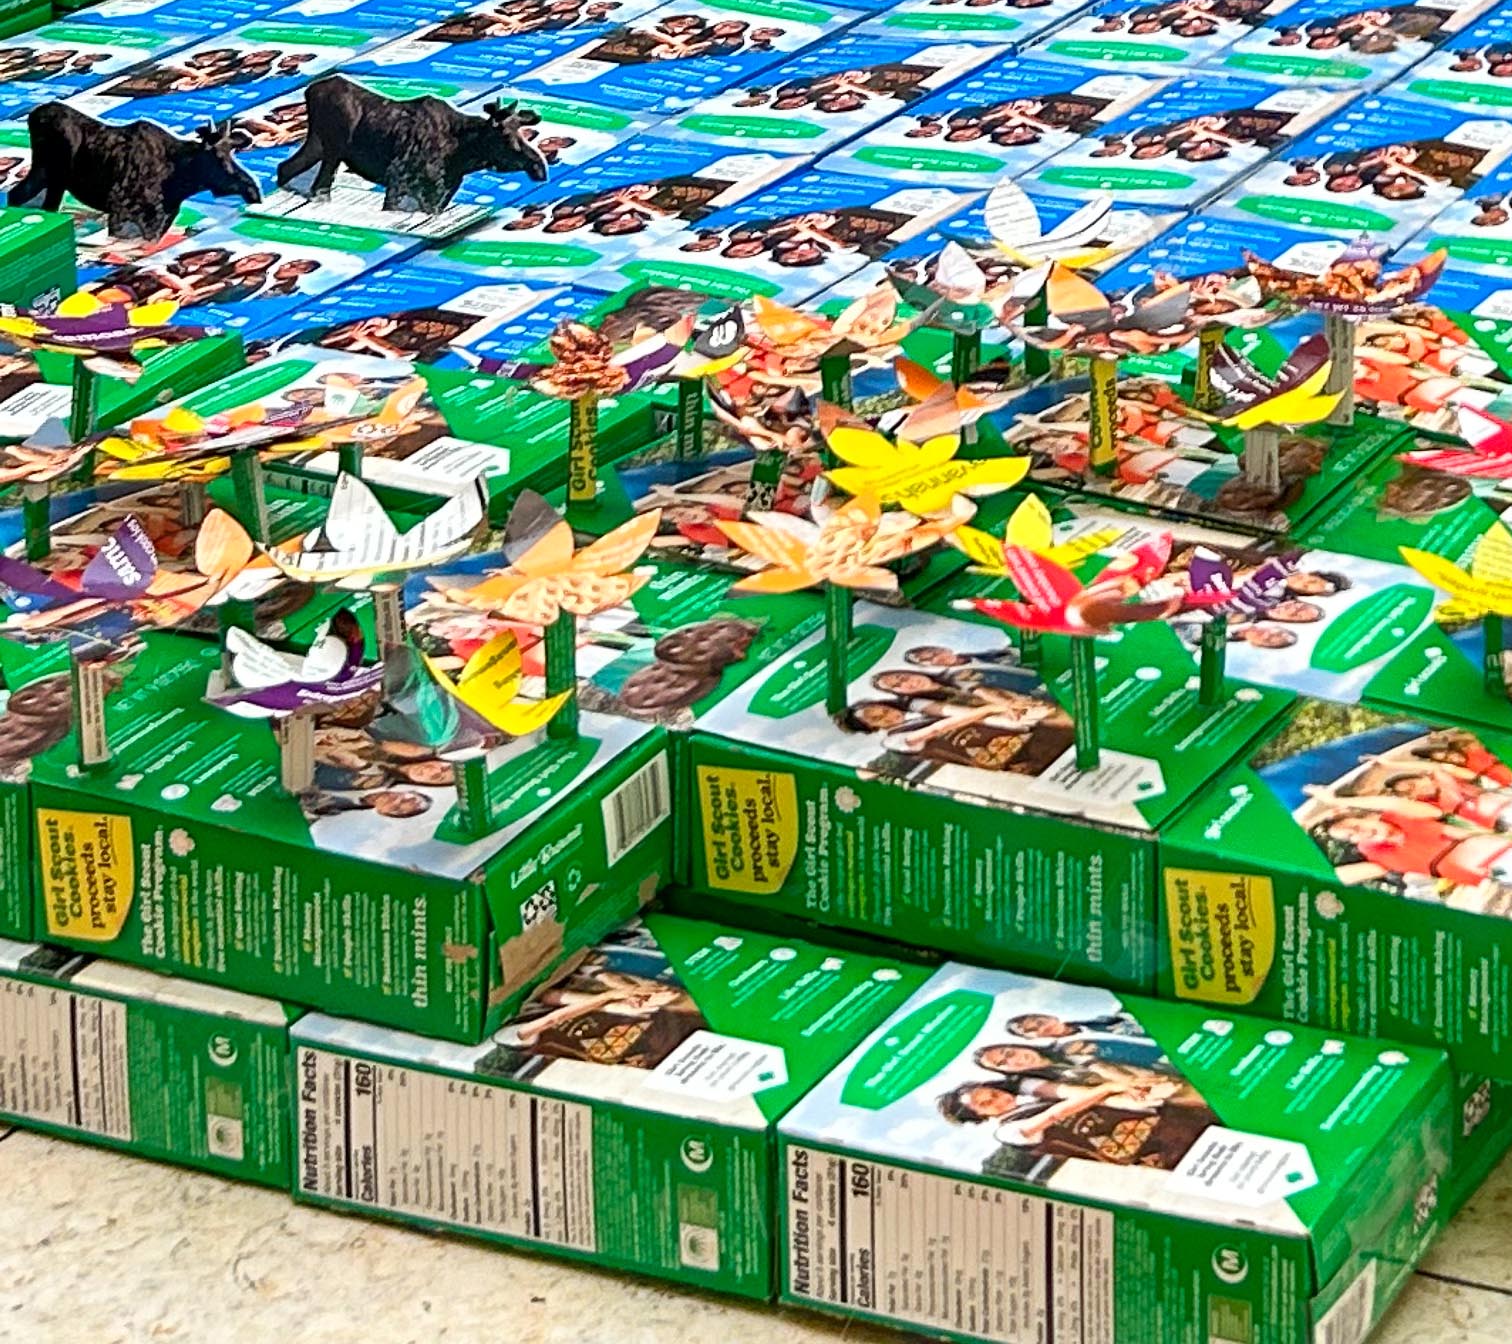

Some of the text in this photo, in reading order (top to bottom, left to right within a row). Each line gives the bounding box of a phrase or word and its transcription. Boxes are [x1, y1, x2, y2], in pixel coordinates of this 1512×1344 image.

[46, 818, 69, 927] Girl Scout
[706, 775, 730, 880] Girl Scout
[742, 798, 769, 883] proceeds
[765, 828, 780, 868] stay
[805, 800, 817, 908] The Girl Scout
[81, 842, 105, 929] proceeds
[103, 872, 117, 913] stay
[1175, 878, 1198, 990] Girl Scout
[411, 965, 428, 1007] thin
[1086, 920, 1102, 962] thin
[1215, 903, 1241, 992] proceeds
[1239, 934, 1254, 976] stay
[302, 1050, 318, 1190] Nutrition Facts
[355, 1062, 373, 1202] Calories 160
[792, 1150, 810, 1294] Nutrition Facts
[852, 1162, 870, 1307] Calories 160
